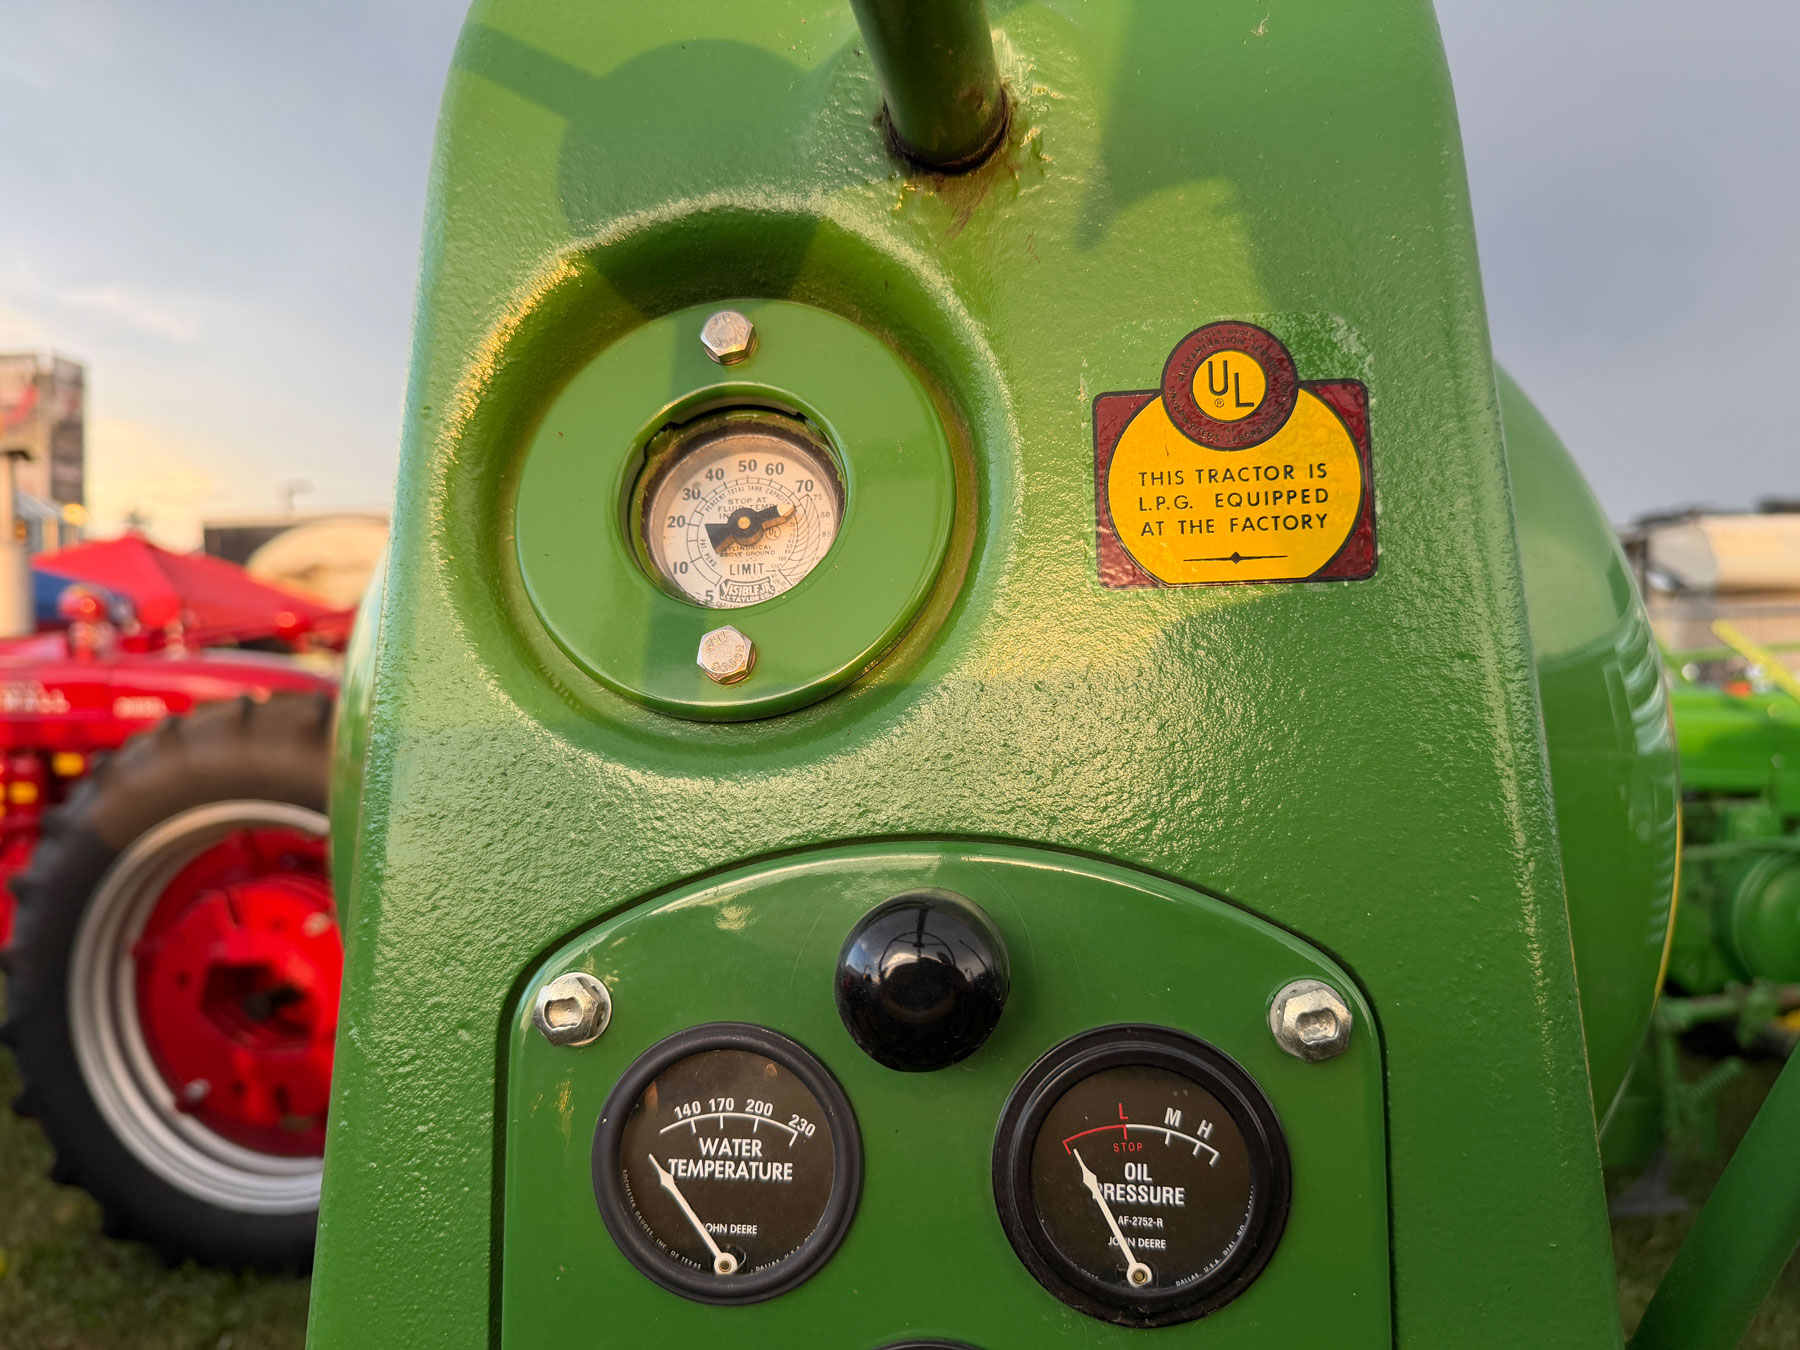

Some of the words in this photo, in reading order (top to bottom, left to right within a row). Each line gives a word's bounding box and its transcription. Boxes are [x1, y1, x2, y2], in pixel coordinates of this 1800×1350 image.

[1228, 329, 1255, 339] UNDER
[1208, 360, 1254, 408] UL
[738, 459, 757, 472] 50
[765, 462, 784, 475] 60
[705, 468, 724, 481] 40
[1138, 470, 1184, 486] THIS
[1195, 465, 1294, 484] TRACTOR
[1309, 463, 1327, 479] IS
[795, 479, 814, 493] 70
[682, 488, 701, 500] 30
[705, 494, 726, 512] PERCENT
[728, 487, 744, 495] TOTAL
[765, 487, 790, 504] CAPACITY
[1139, 495, 1193, 511] L.P.G.
[1216, 488, 1328, 507] EQUIPPED
[667, 515, 686, 528] 20
[1141, 521, 1164, 536] AT
[1178, 519, 1214, 534] THE
[1230, 514, 1327, 532] FACTORY
[673, 562, 688, 574] 10
[730, 563, 764, 576] LIMIT
[705, 590, 714, 602] 5
[721, 582, 760, 596] VISIBLE
[760, 582, 774, 594] JR.
[674, 1101, 701, 1120] 140
[708, 1098, 734, 1112] 170
[745, 1099, 773, 1116] 200
[788, 1114, 815, 1137] 230
[1119, 1103, 1128, 1120] L
[1164, 1107, 1182, 1127] M
[1197, 1119, 1213, 1139] H
[699, 1137, 762, 1157] WATER
[1113, 1142, 1143, 1152] STOP
[668, 1159, 793, 1180] TEMPERATURE
[1124, 1162, 1152, 1181] OIL
[623, 1169, 636, 1208] ROCHESTER
[656, 1238, 668, 1251] INC.
[670, 1250, 679, 1258] OF
[682, 1257, 701, 1269] TEXAS
[1118, 1215, 1163, 1227] AF-2752-R
[704, 1223, 727, 1233] OHN
[730, 1224, 757, 1234] DEERE
[1108, 1236, 1136, 1246] JON
[1138, 1238, 1166, 1248] DEERE
[1203, 1258, 1221, 1272] U.S.A.
